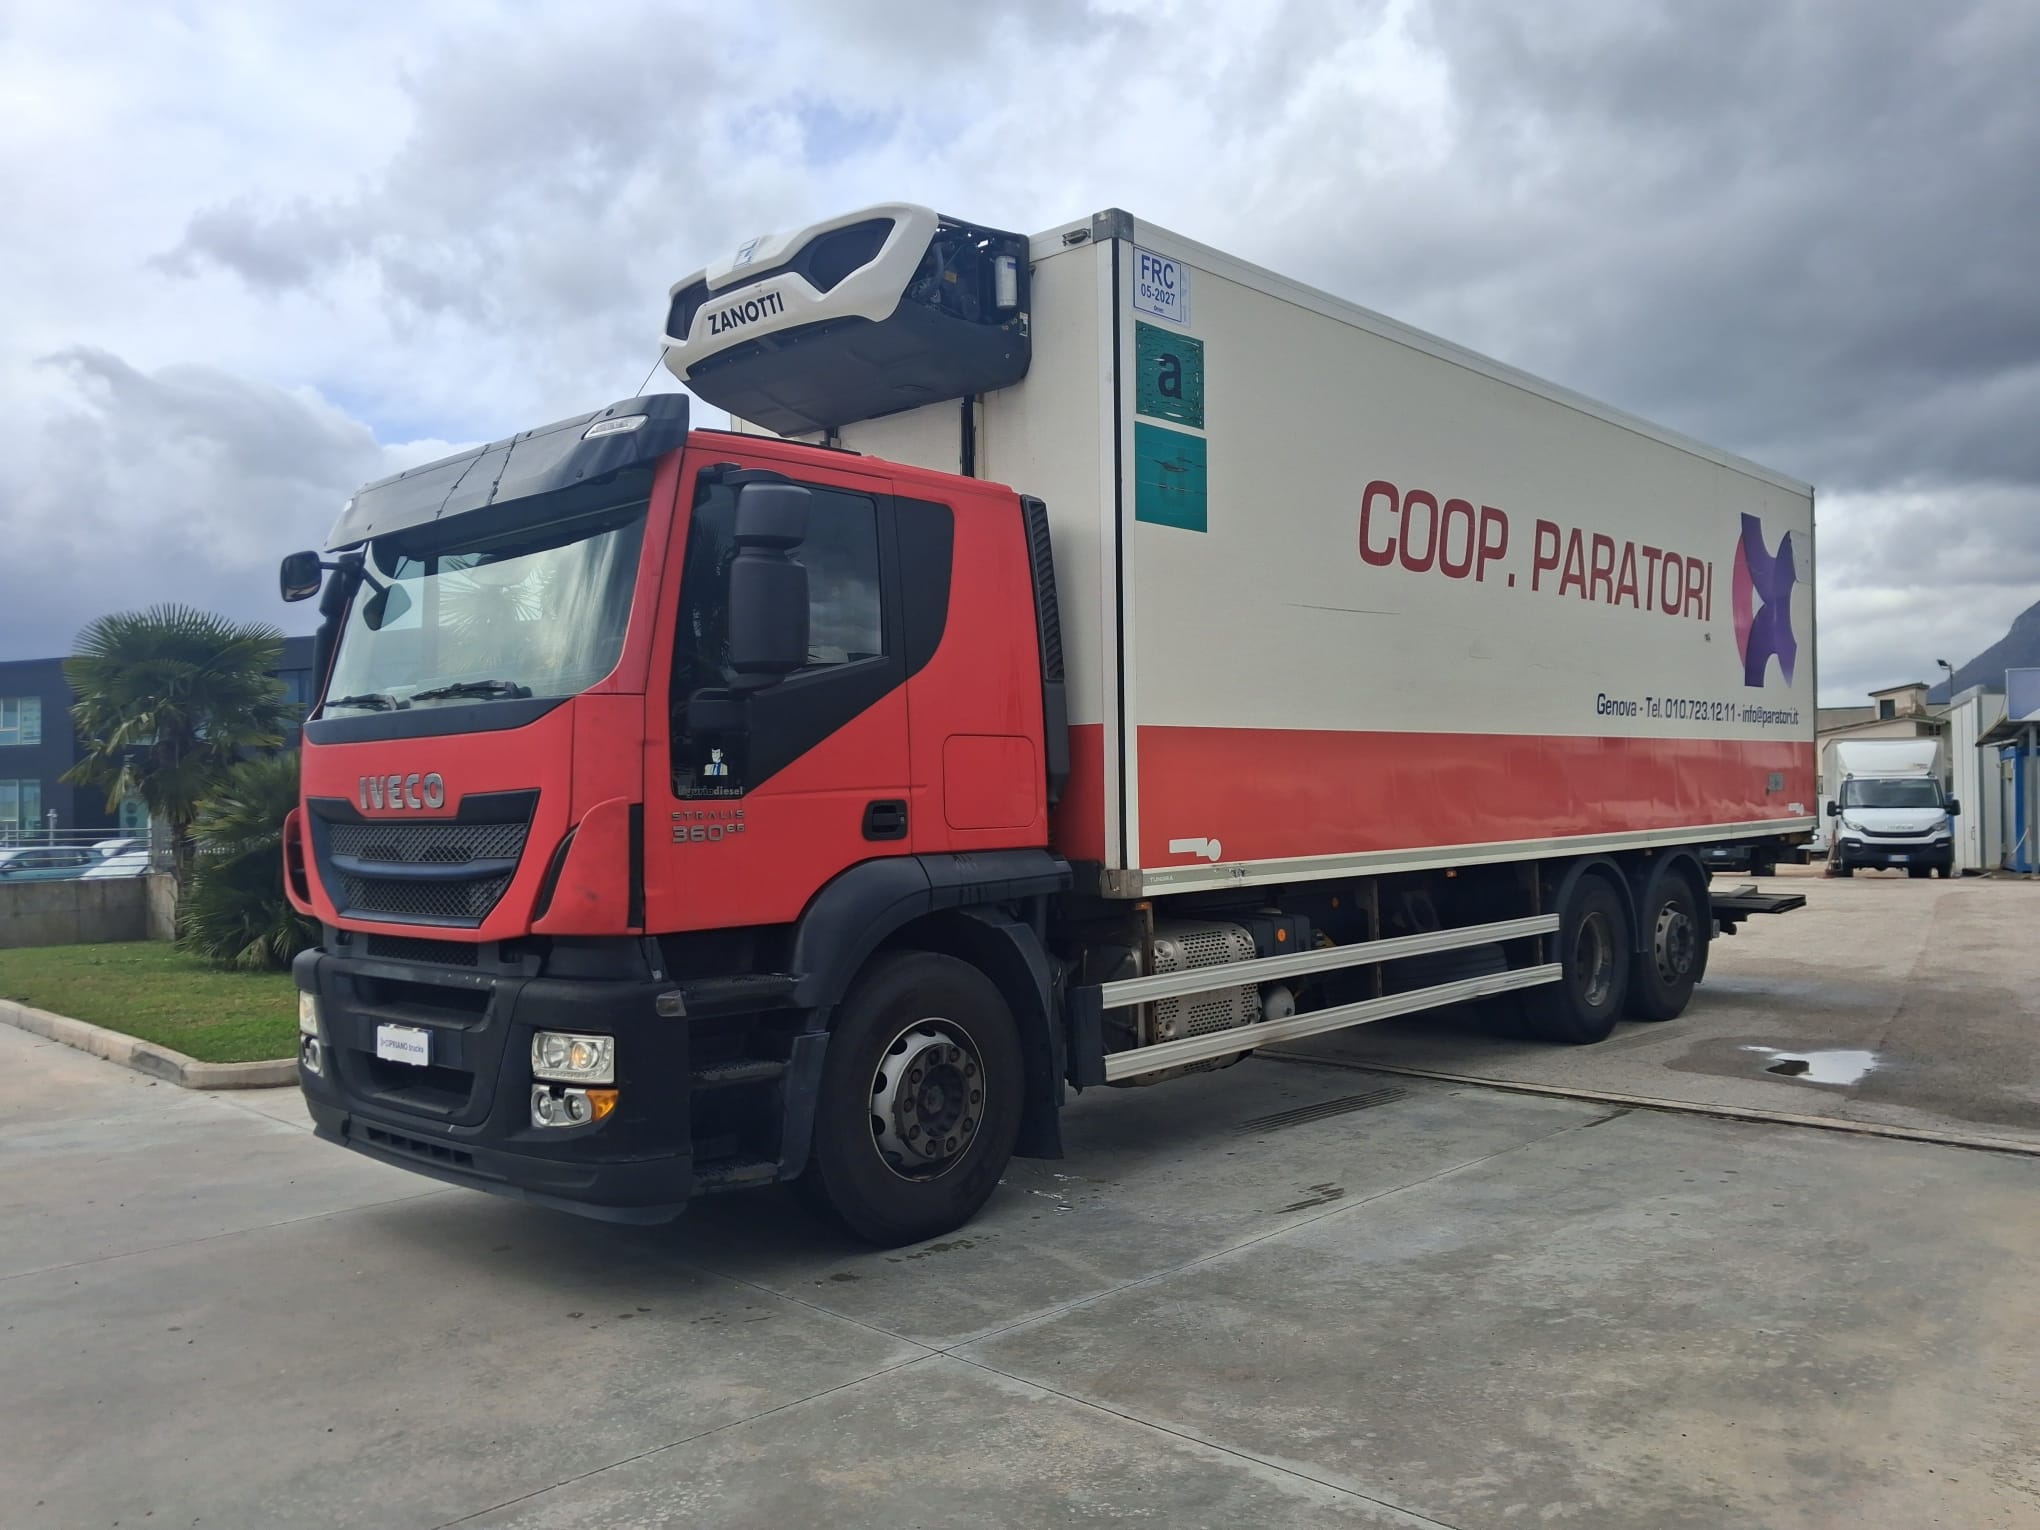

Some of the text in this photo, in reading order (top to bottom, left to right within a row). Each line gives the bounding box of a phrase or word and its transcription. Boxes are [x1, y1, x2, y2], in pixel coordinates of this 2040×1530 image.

[1141, 254, 1174, 289] FRC
[1140, 283, 1175, 306] 05-2027
[707, 291, 784, 335] ZANOTTI
[1158, 353, 1182, 399] a
[1359, 480, 1713, 622] COOP. PARATORI
[1597, 693, 1637, 716] Genova
[1646, 697, 1662, 718] Tel.
[1665, 698, 1735, 722] 010.723.12.11
[1743, 704, 1800, 728] info@paratori.it
[359, 773, 444, 810] IVECO
[672, 809, 745, 820] STRALIS
[672, 825, 724, 843] 360
